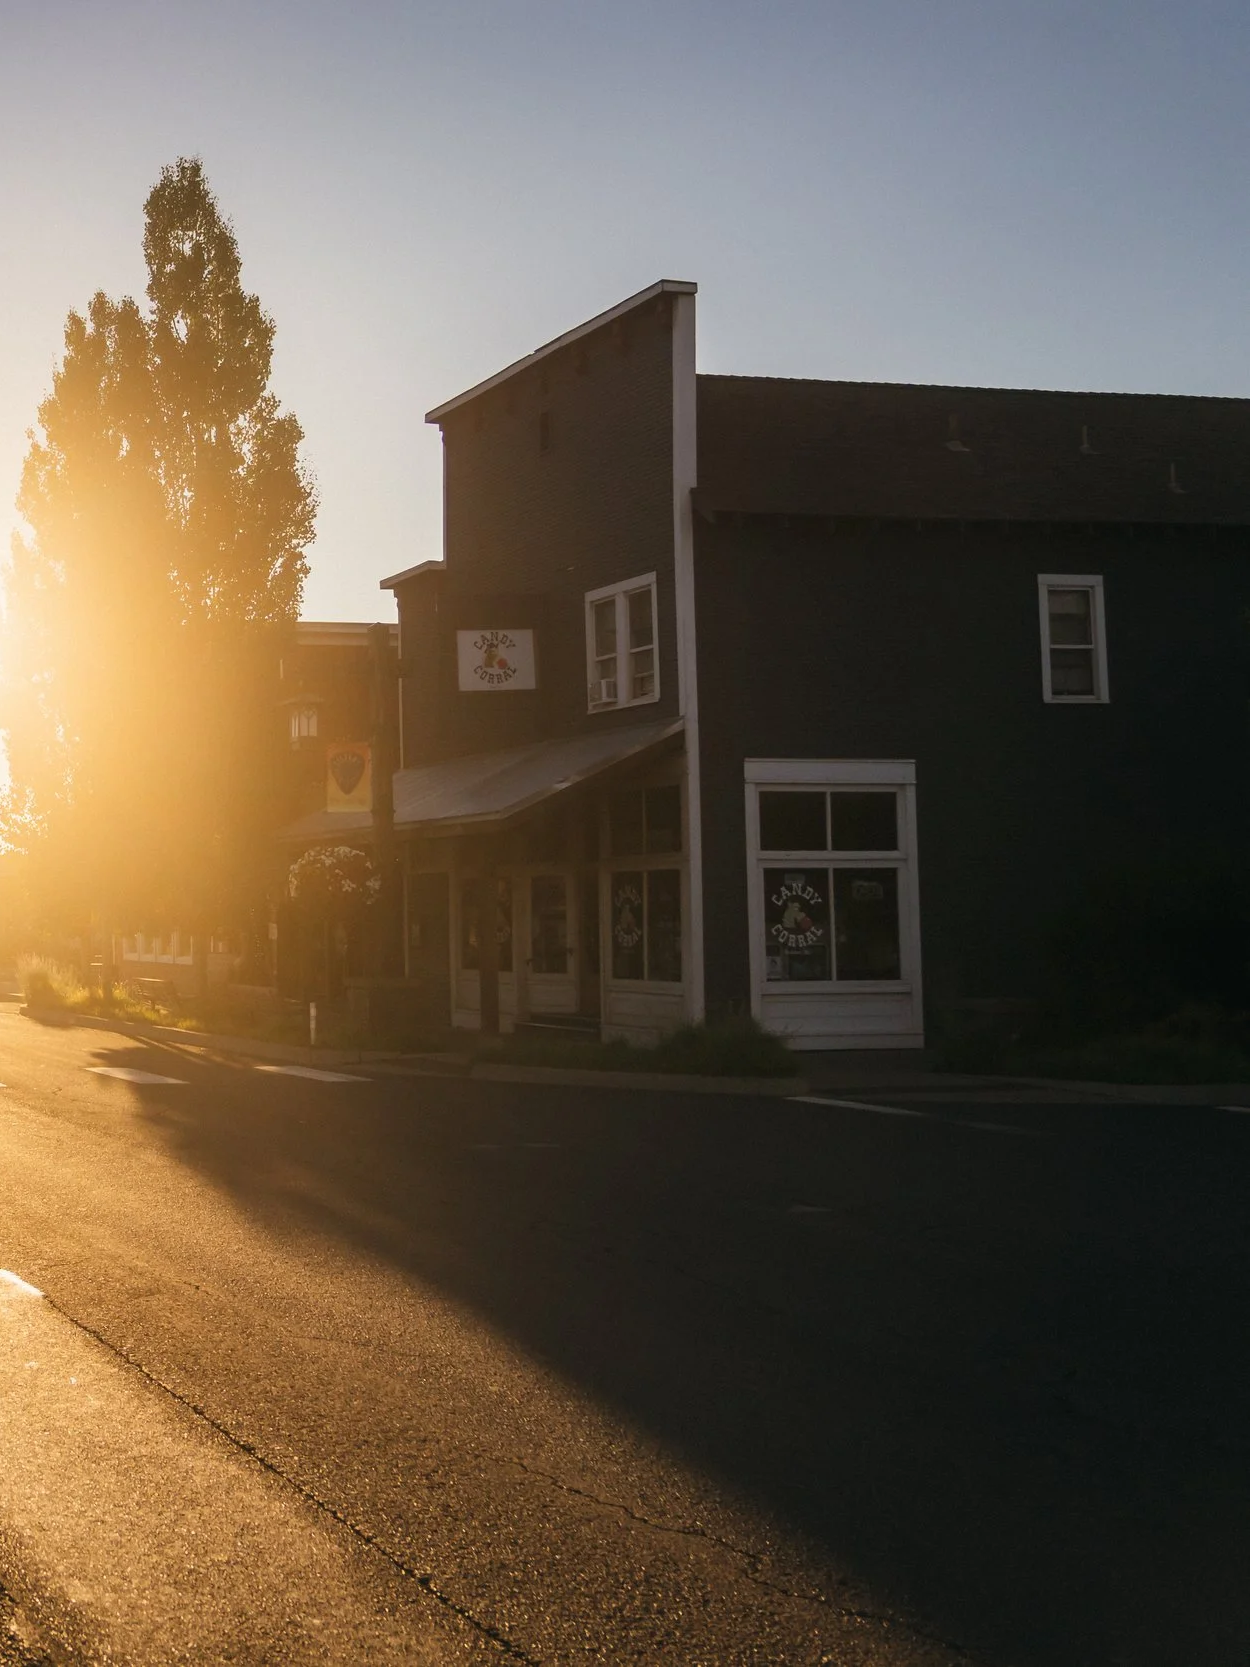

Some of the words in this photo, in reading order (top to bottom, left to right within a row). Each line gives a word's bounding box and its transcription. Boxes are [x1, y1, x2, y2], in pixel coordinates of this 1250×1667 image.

[473, 631, 516, 650] CANDY
[473, 665, 517, 684] CORRAL
[771, 883, 823, 906] CANDY
[771, 923, 823, 947] CORRAL
